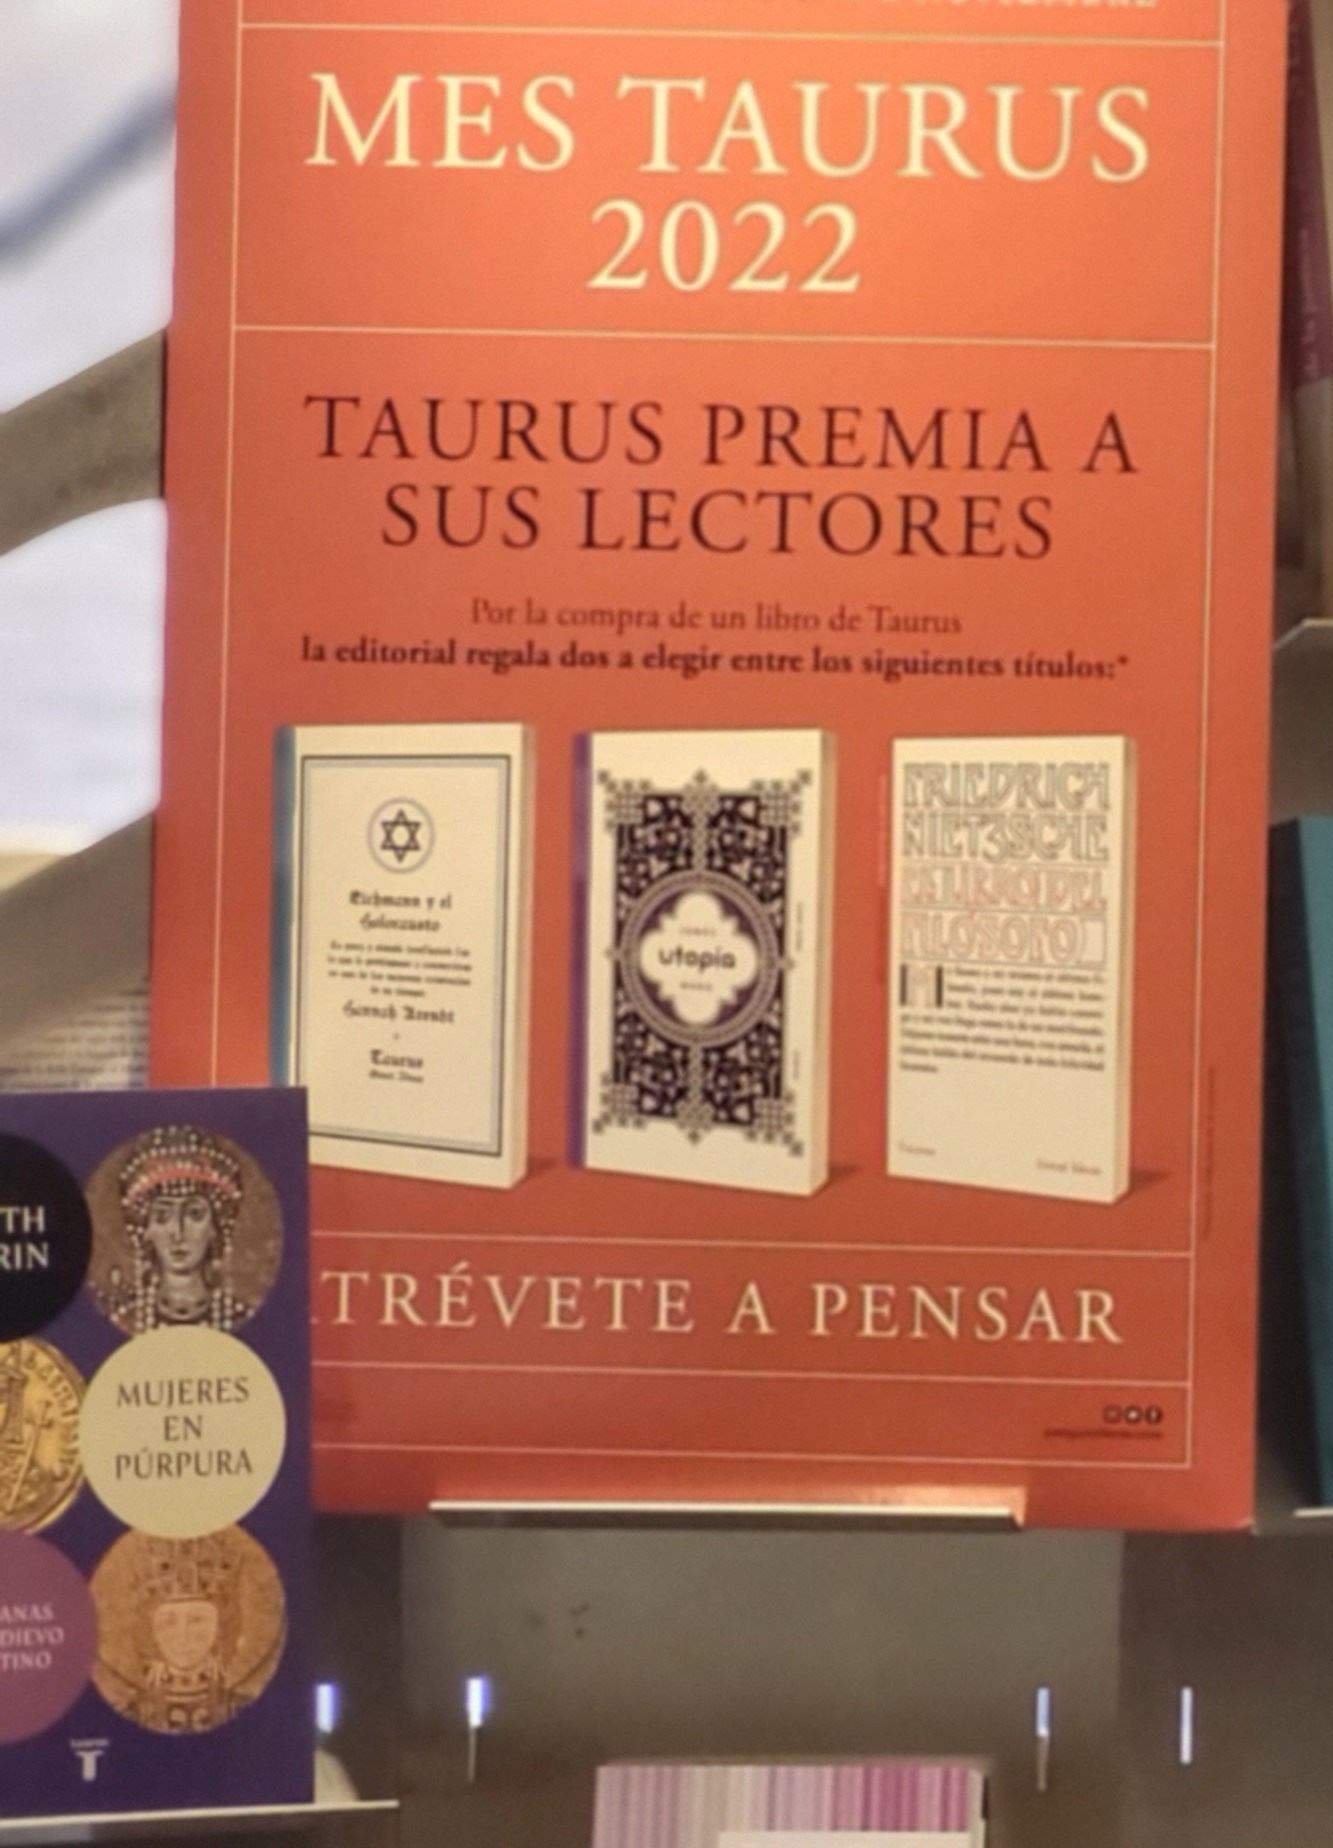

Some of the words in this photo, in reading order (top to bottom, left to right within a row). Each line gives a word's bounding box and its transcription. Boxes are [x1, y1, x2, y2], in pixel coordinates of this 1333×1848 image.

[304, 72, 577, 173] MES
[618, 76, 1151, 184] TAURUS
[586, 197, 861, 294] 2022
[304, 394, 665, 466] TAURUS
[702, 402, 1052, 475] PREMIA
[1081, 409, 1139, 476] A
[381, 483, 541, 549] SUS
[578, 486, 1054, 561] LECTORES
[470, 597, 517, 626] Por
[526, 597, 549, 627] la
[556, 605, 660, 636] compra
[668, 601, 702, 629] de
[710, 608, 747, 631] un
[755, 601, 821, 631] libro
[828, 604, 862, 632] de
[868, 605, 963, 635] Taurus
[301, 635, 327, 663] la
[334, 635, 458, 667] editorial
[465, 640, 551, 675] regala
[559, 641, 610, 669] dos
[618, 646, 634, 669] a
[642, 643, 723, 681] elegir
[729, 650, 804, 673] entre
[812, 645, 853, 673] los
[862, 648, 1005, 684] siguientes
[902, 763, 1110, 811] FRIEDRICH
[311, 1261, 695, 1336] TRÉVETE
[725, 1280, 777, 1337] A
[808, 1283, 1126, 1346] PENSAR
[116, 1377, 252, 1408] MUJERES
[163, 1415, 203, 1443] EN
[114, 1446, 254, 1480] PÚRPURA
